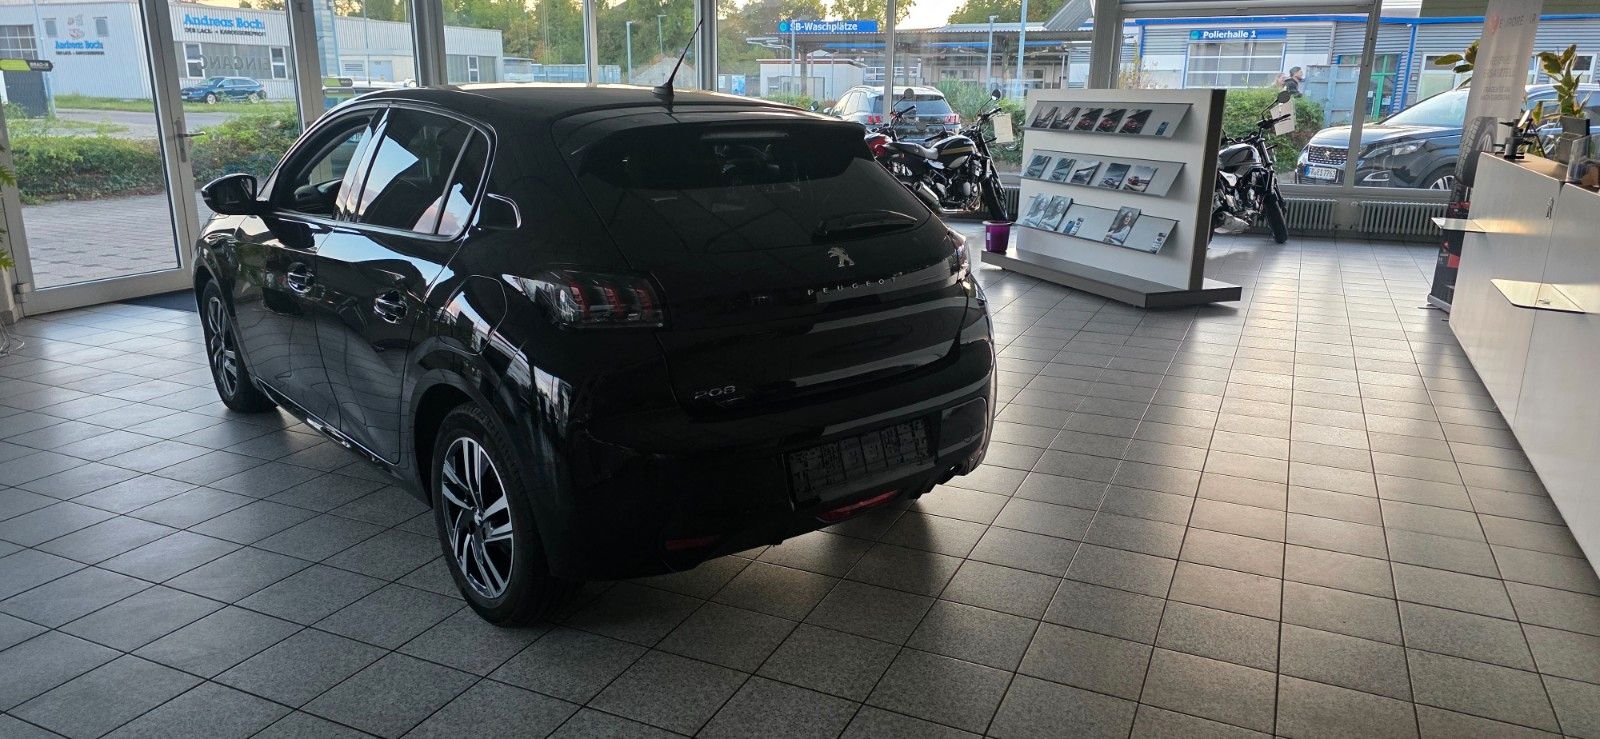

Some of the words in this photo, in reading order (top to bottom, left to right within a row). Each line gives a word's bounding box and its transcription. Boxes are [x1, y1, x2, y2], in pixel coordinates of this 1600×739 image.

[184, 14, 233, 28] Andreas
[235, 17, 265, 29] Boch
[790, 21, 858, 32] SB-Waschplätze
[1203, 30, 1249, 39] Polierhalle
[1250, 30, 1257, 38] 1
[807, 273, 901, 296] PEUGEOT
[694, 385, 736, 400] 208
